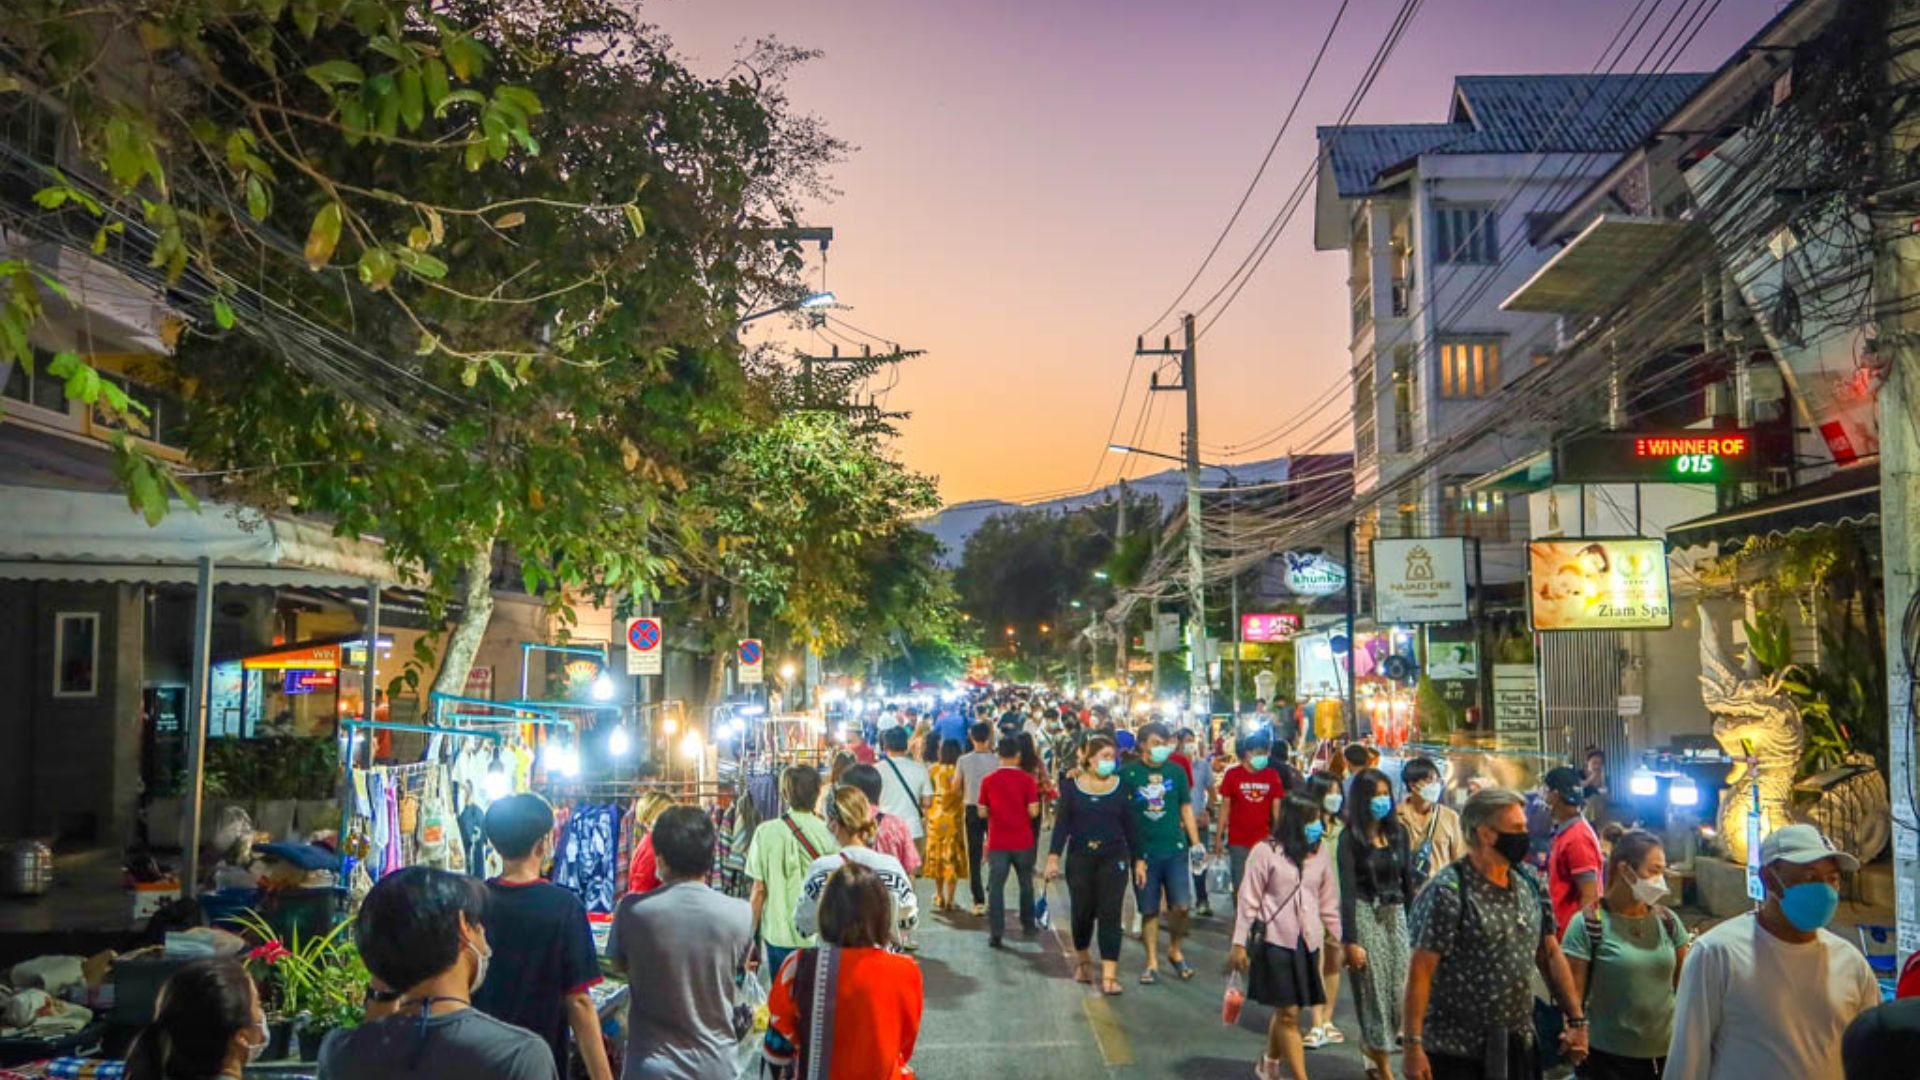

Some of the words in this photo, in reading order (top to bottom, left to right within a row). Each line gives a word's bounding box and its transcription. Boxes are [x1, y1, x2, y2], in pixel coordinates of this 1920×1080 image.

[1648, 439, 1719, 455] WINNER
[1721, 439, 1744, 454] OF
[1677, 455, 1713, 472] 015
[1598, 604, 1636, 617] Ziam
[1641, 603, 1668, 619] Spa
